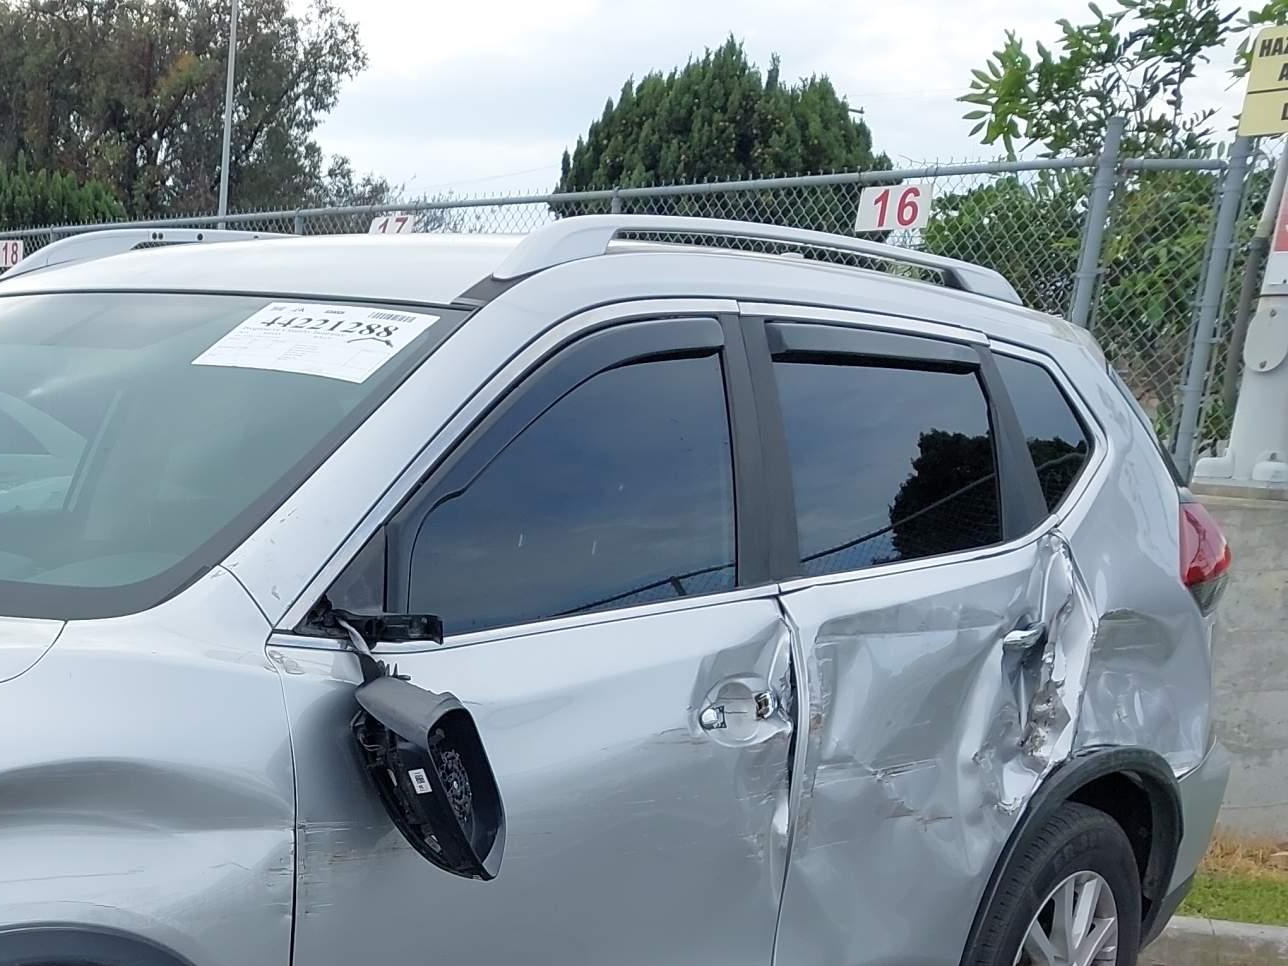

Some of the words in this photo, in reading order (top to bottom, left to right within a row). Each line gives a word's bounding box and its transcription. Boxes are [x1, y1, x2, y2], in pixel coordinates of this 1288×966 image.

[874, 187, 920, 227] 16
[378, 216, 408, 233] 17
[2, 241, 18, 265] 18
[260, 315, 399, 338] 44221288
